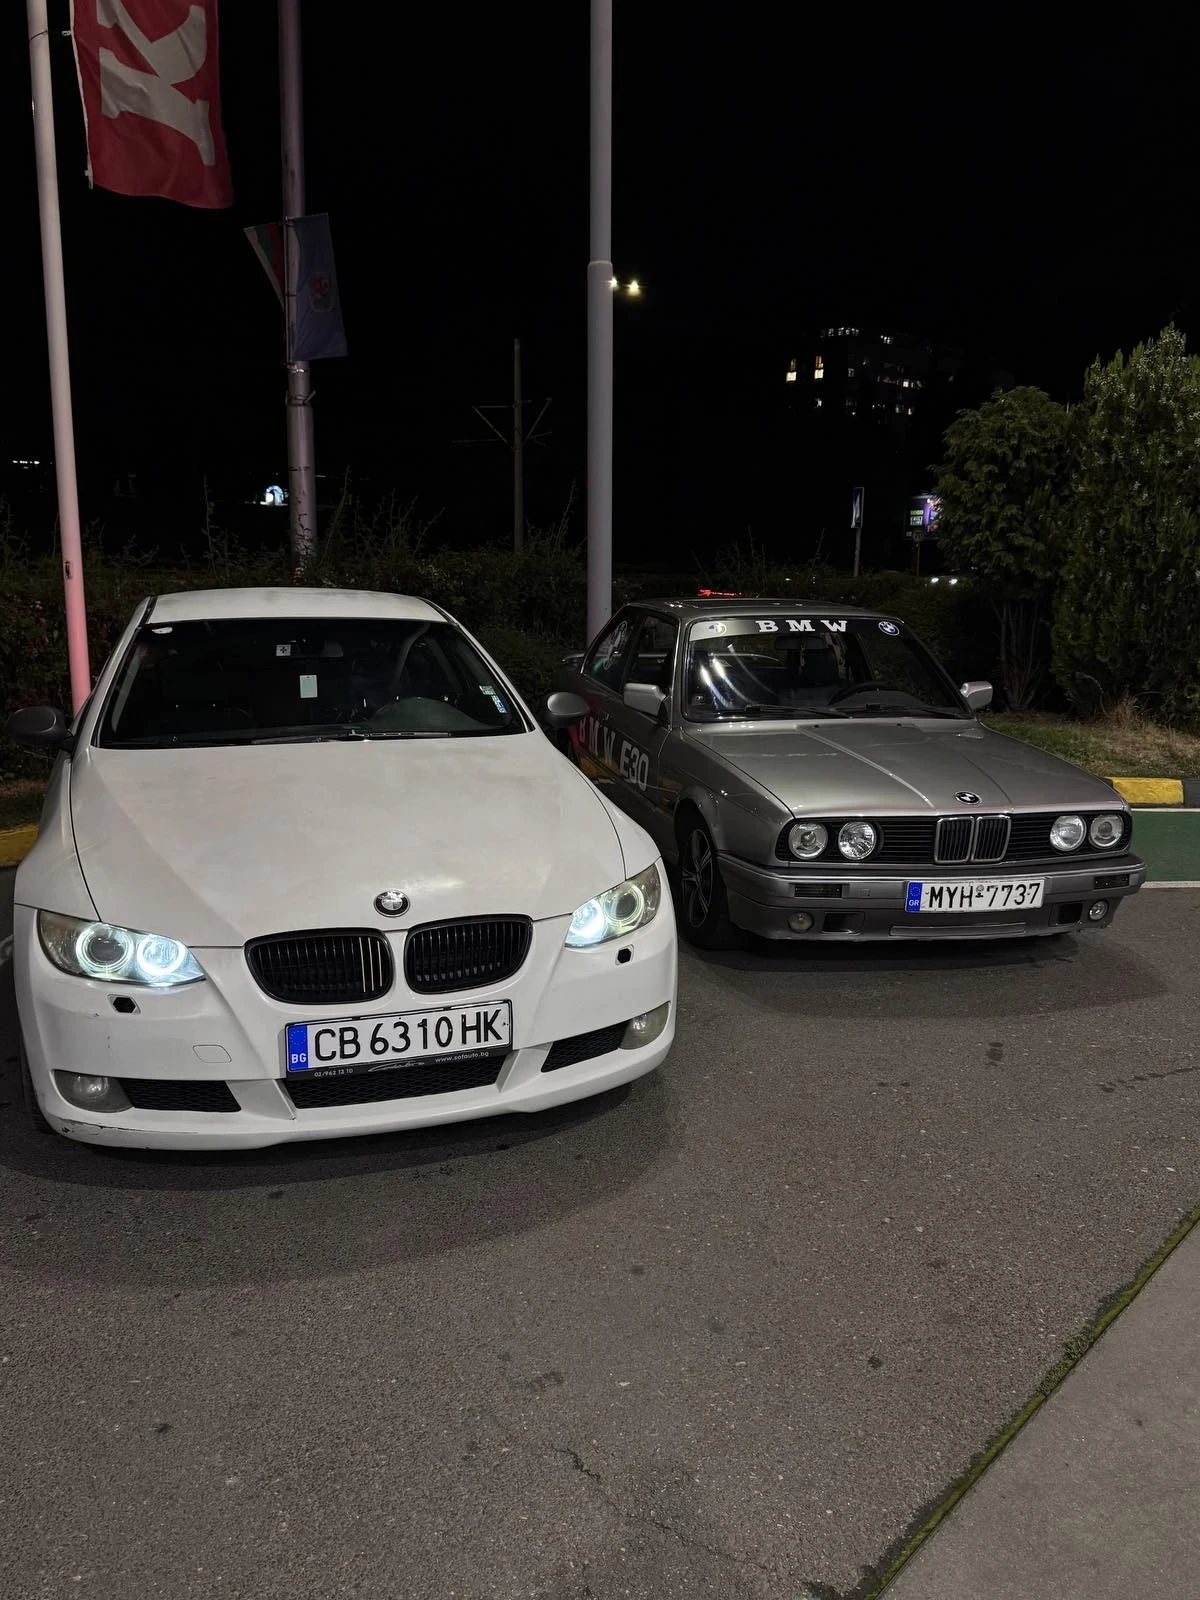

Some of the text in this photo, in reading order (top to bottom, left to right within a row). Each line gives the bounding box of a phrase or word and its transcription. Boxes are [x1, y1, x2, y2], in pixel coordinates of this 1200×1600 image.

[620, 740, 650, 792] E30
[908, 899, 920, 907] GR
[314, 1008, 503, 1061] CB 6310 HK
[291, 1053, 307, 1064] BG
